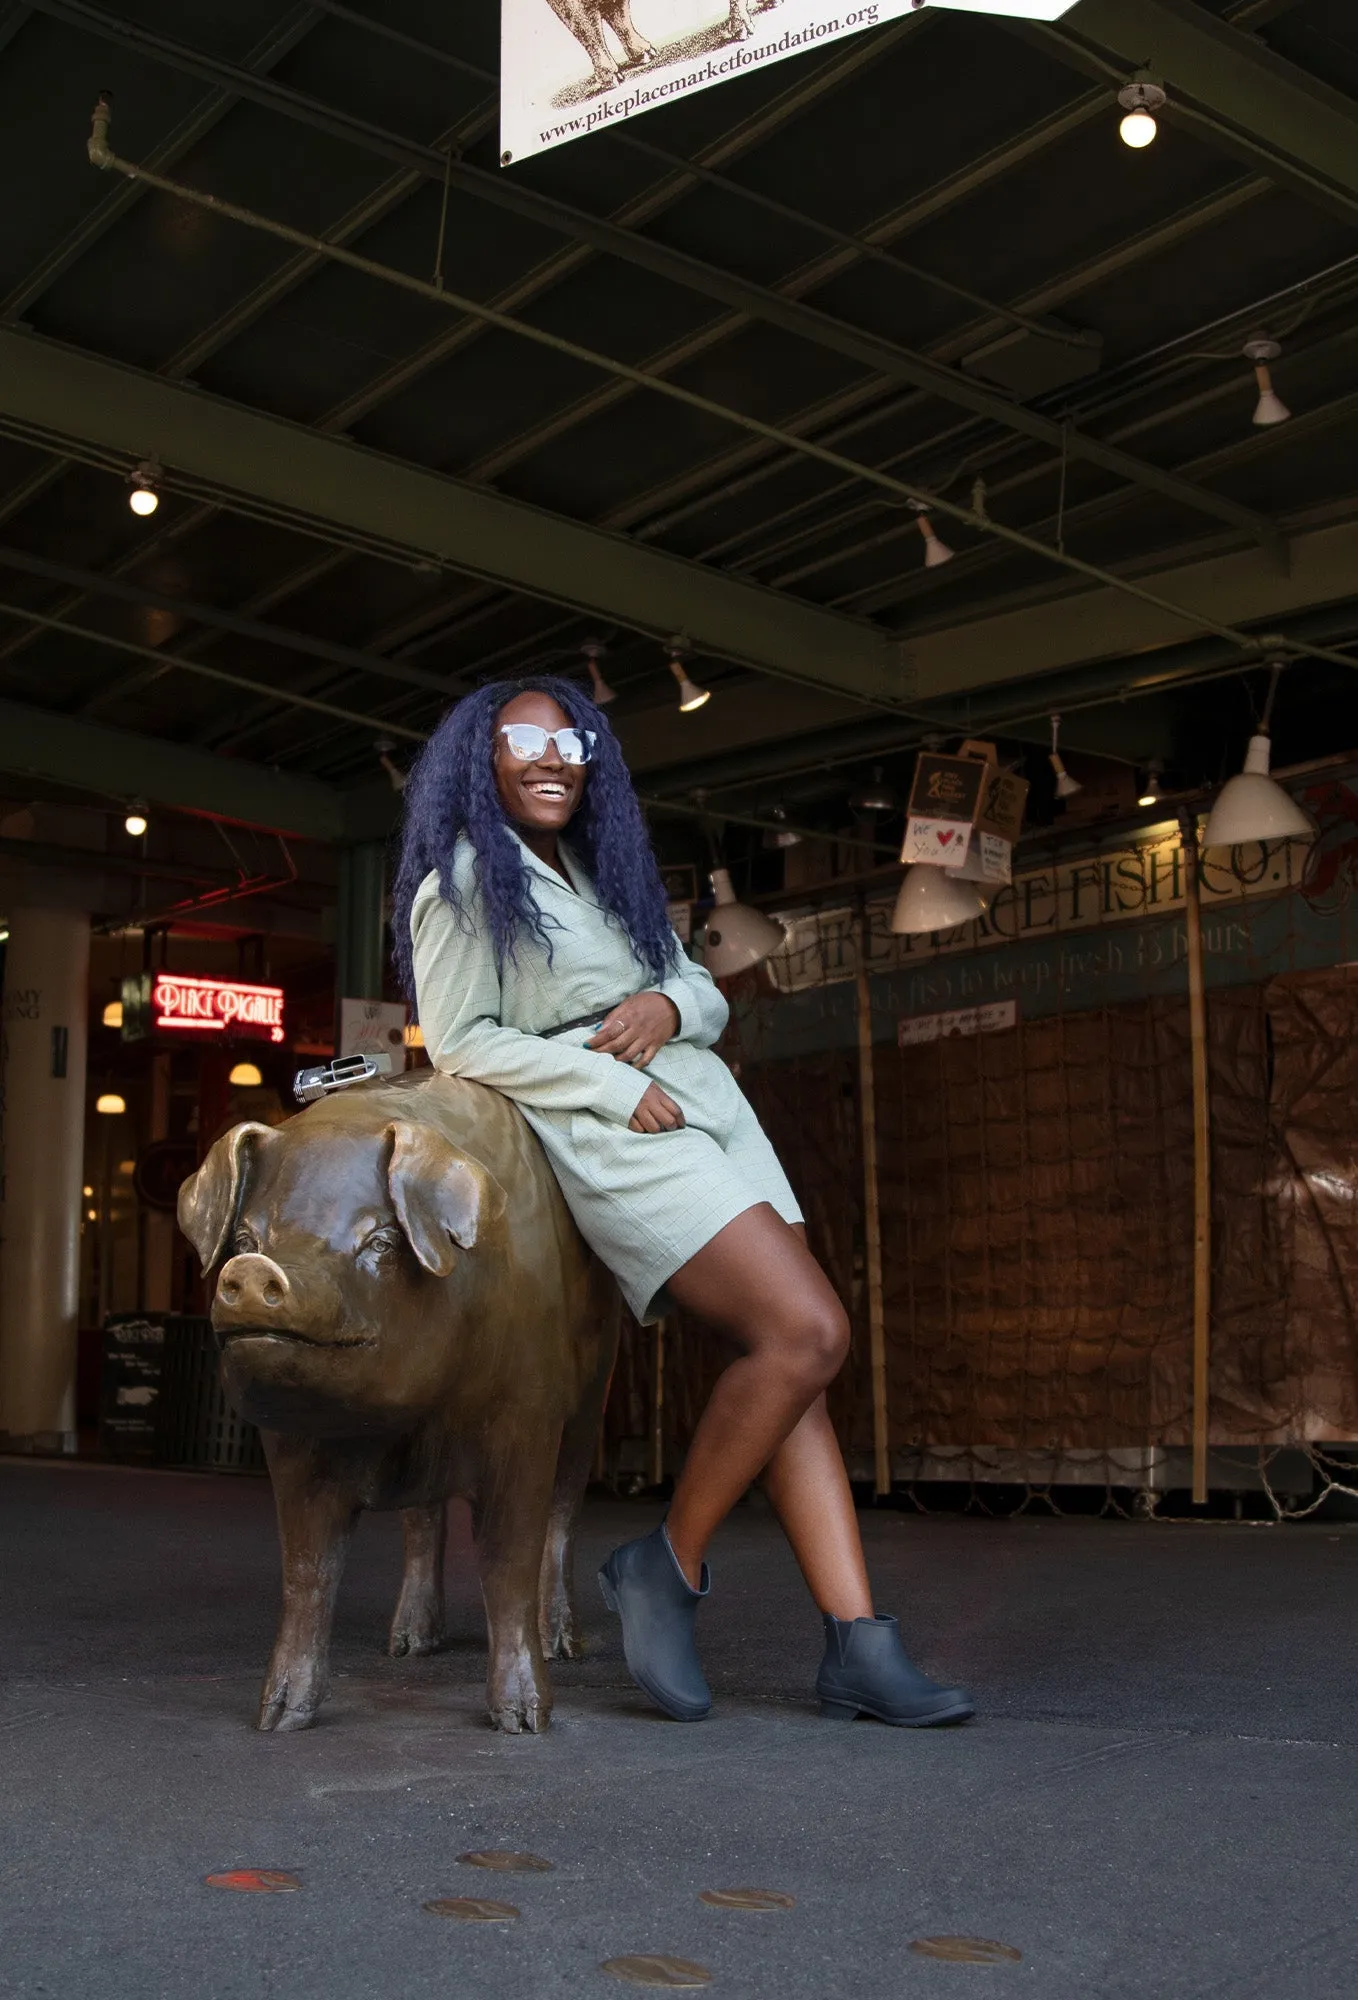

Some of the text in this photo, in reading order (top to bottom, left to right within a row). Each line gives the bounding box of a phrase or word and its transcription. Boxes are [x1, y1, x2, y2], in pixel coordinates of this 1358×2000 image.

[538, 2, 880, 145] www.pikeplacemarketfoundation.org
[1069, 846, 1185, 921] FISH
[1196, 838, 1281, 896] CO.
